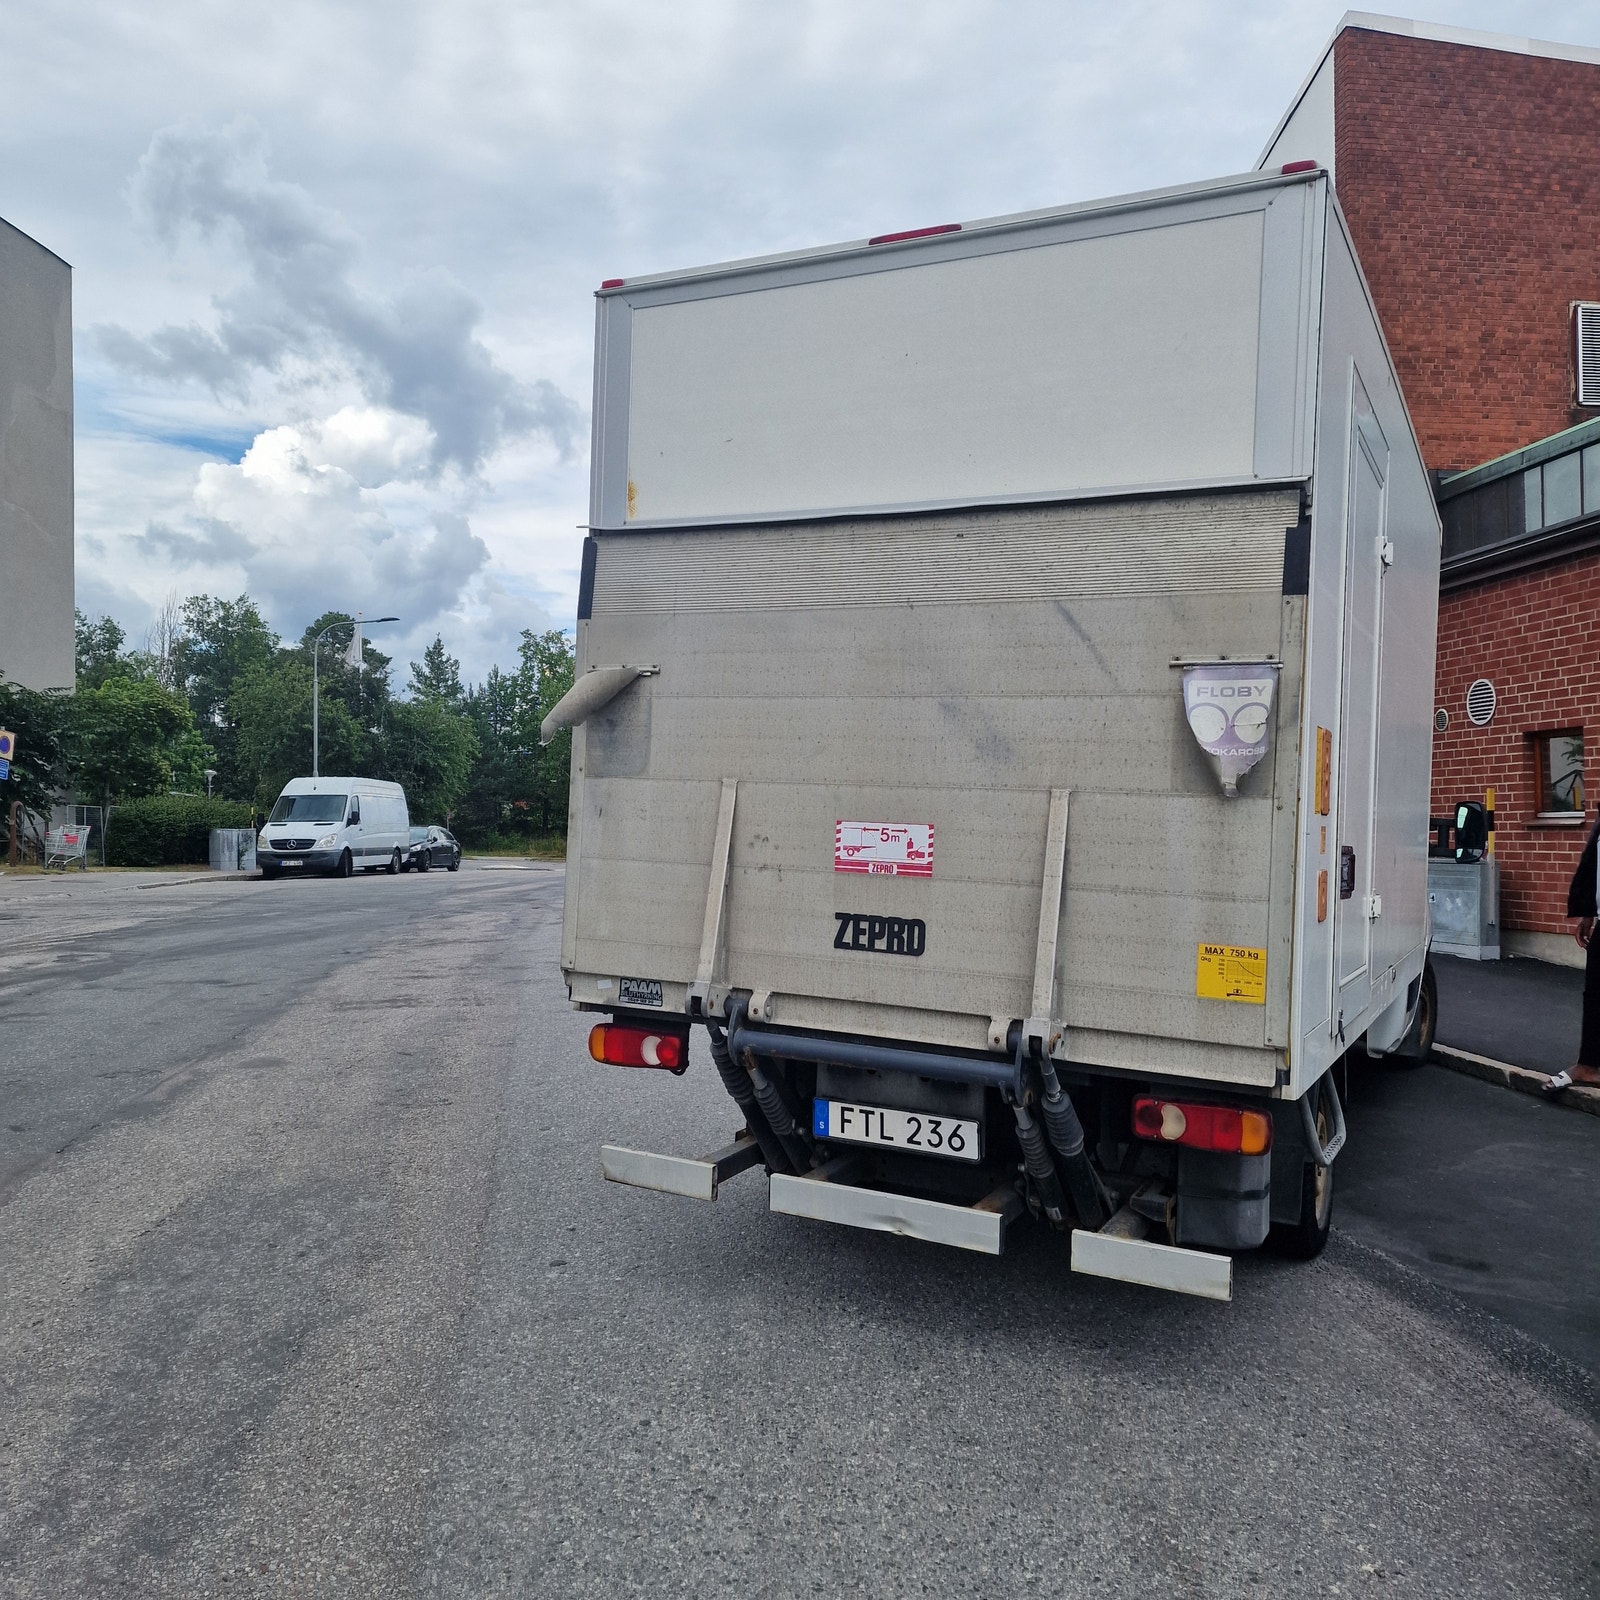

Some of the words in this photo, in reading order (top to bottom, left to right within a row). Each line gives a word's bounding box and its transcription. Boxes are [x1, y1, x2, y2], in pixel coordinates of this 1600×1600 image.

[1196, 686, 1267, 697] FLOBY
[871, 863, 894, 874] ZEPRO
[834, 912, 926, 956] ZEPRO
[1204, 946, 1225, 956] MAX
[1230, 949, 1246, 957] 750
[1247, 951, 1259, 960] kg
[621, 979, 662, 995] PAAM
[819, 1121, 825, 1129] S
[840, 1106, 894, 1141] FTL
[906, 1116, 966, 1152] 236
